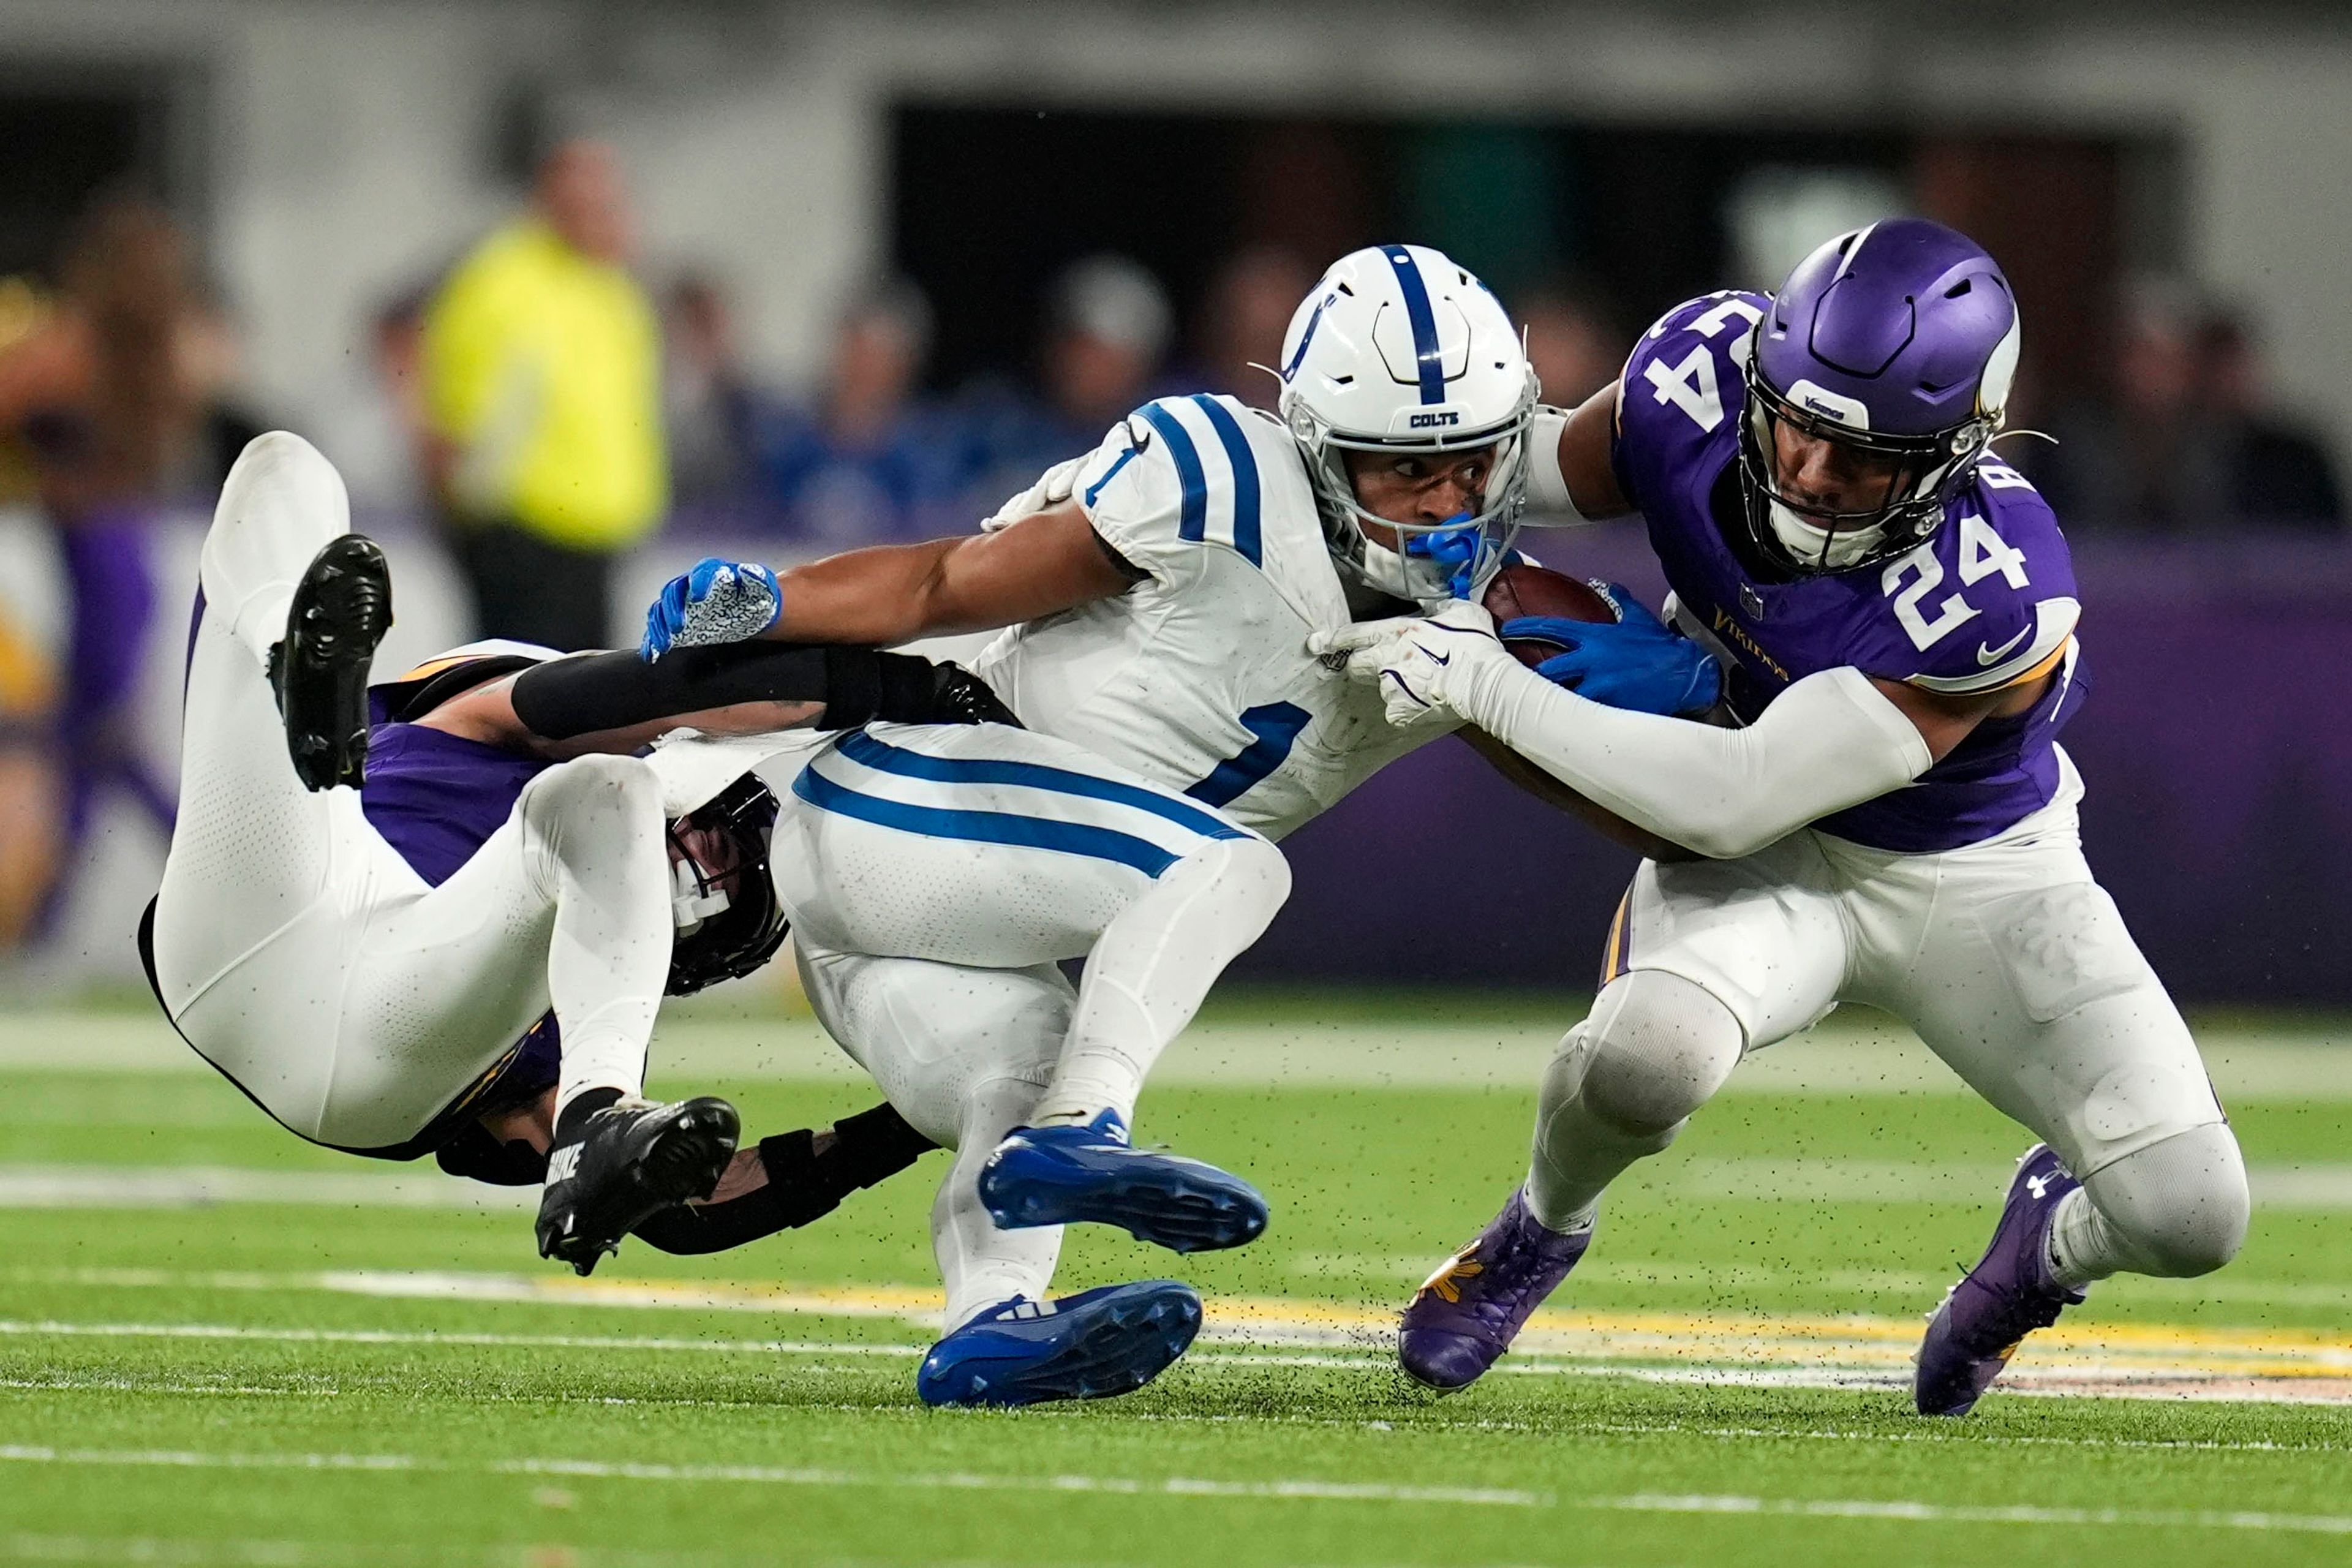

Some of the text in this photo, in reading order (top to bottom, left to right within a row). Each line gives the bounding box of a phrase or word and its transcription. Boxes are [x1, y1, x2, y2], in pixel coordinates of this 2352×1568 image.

[1410, 412, 1458, 428] COLTS
[1643, 298, 1765, 434] 24
[1881, 513, 2030, 653] 24
